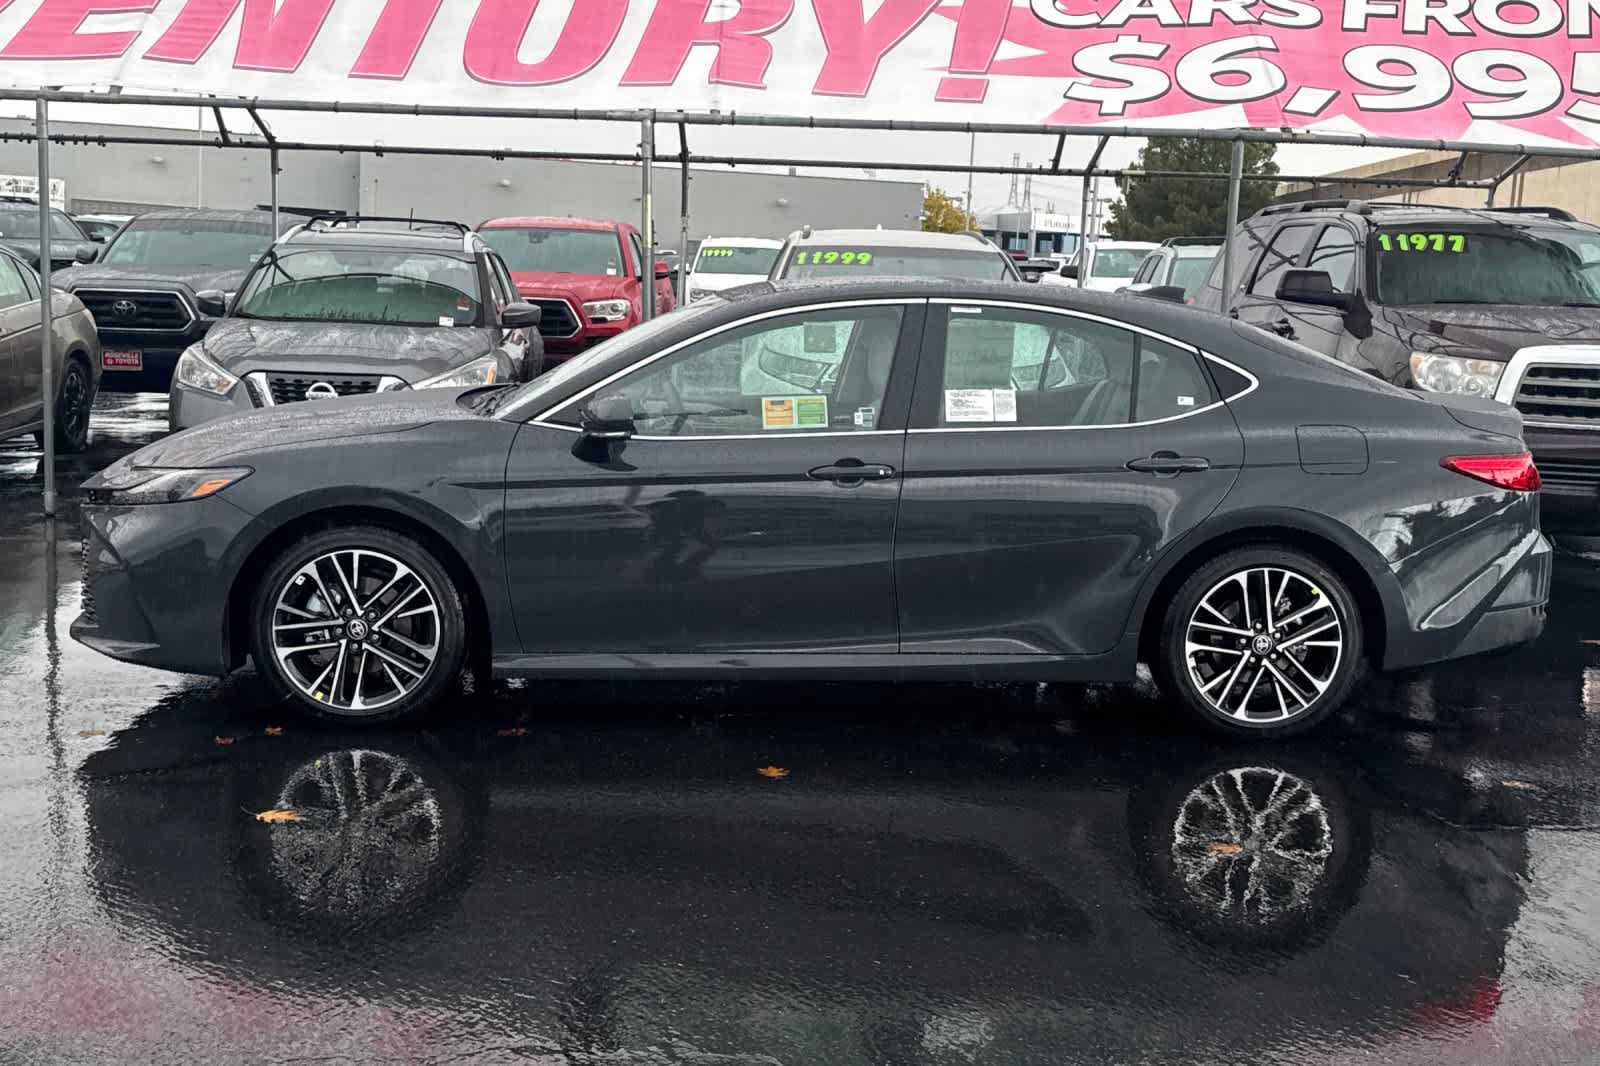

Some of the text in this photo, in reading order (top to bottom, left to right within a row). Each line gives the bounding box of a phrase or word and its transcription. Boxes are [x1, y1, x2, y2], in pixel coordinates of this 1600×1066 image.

[1028, 0, 1324, 30] CARS
[0, 0, 1013, 102] ENTORY!
[1378, 233, 1465, 252] 11977
[796, 251, 872, 265] 11999
